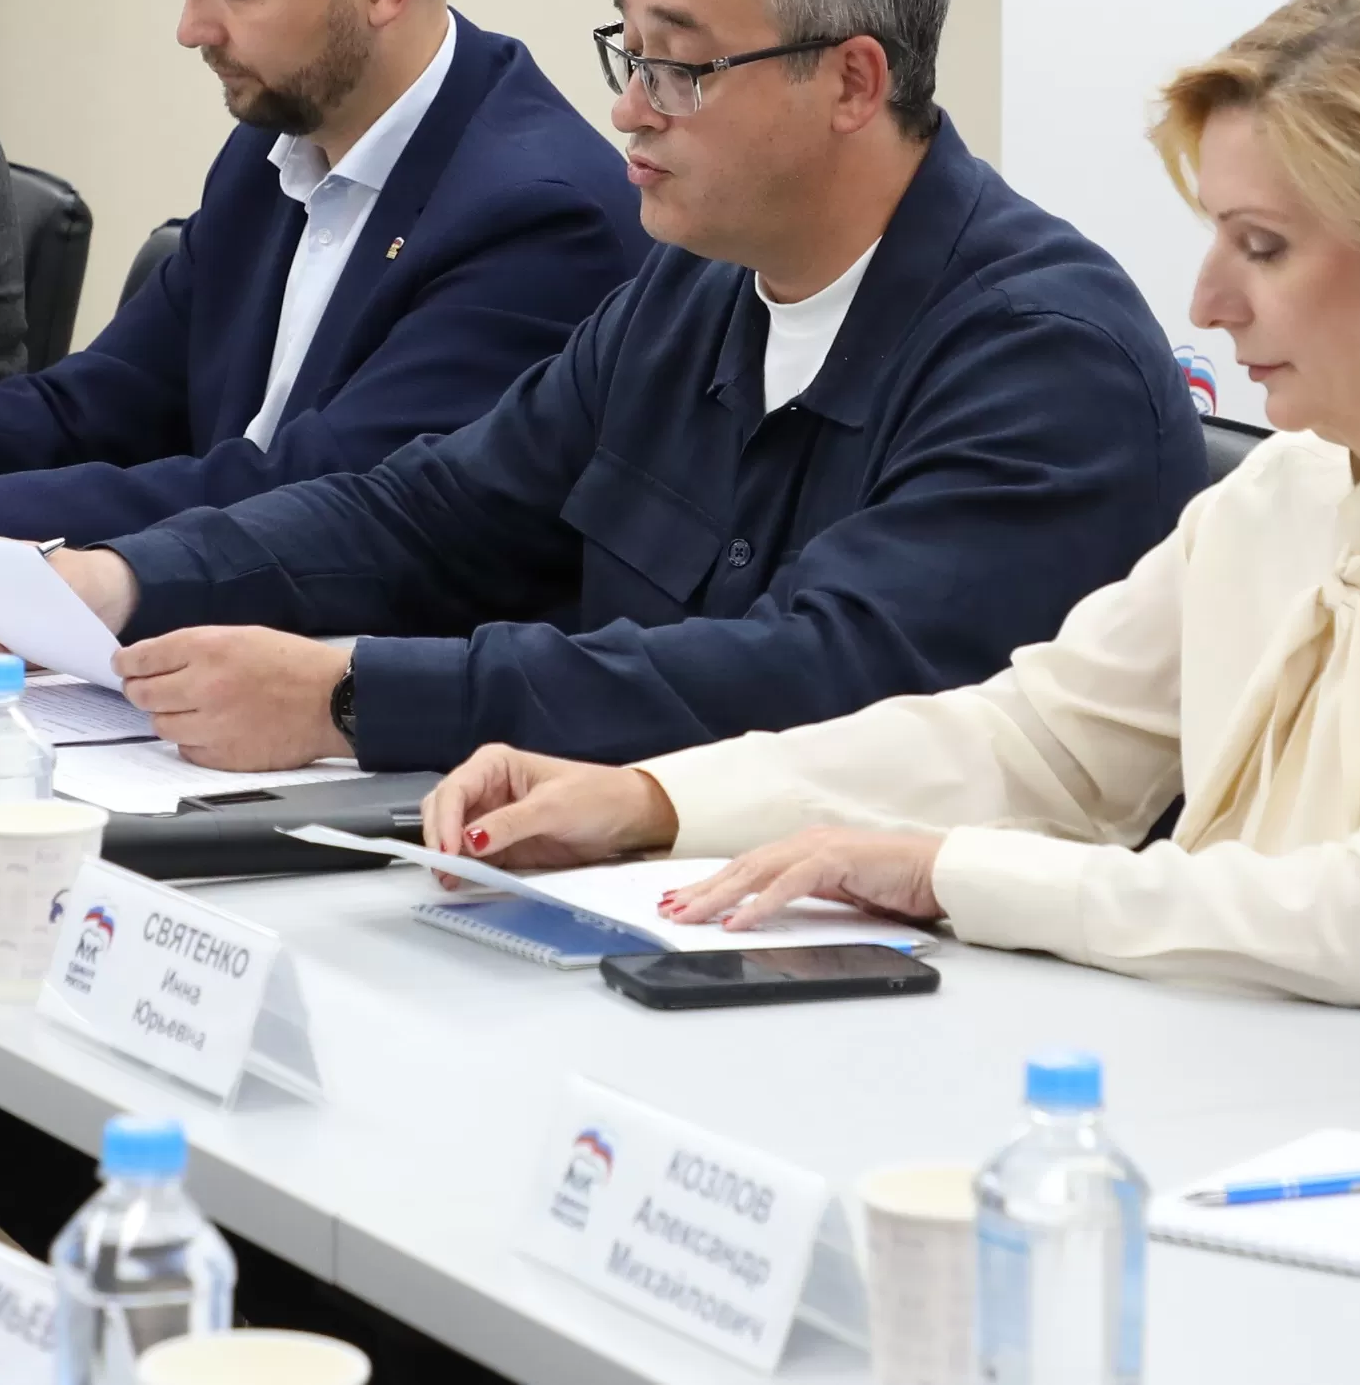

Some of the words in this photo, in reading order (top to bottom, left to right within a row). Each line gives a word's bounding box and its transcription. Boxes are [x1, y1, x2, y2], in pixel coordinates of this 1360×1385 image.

[142, 911, 251, 980] СВЯТЕНКО
[159, 966, 202, 1007] Инна
[131, 997, 207, 1052] Юрьевна
[665, 1148, 777, 1225] КОЗЛОВ
[632, 1195, 772, 1291] Александр
[605, 1237, 768, 1347] Михайлович
